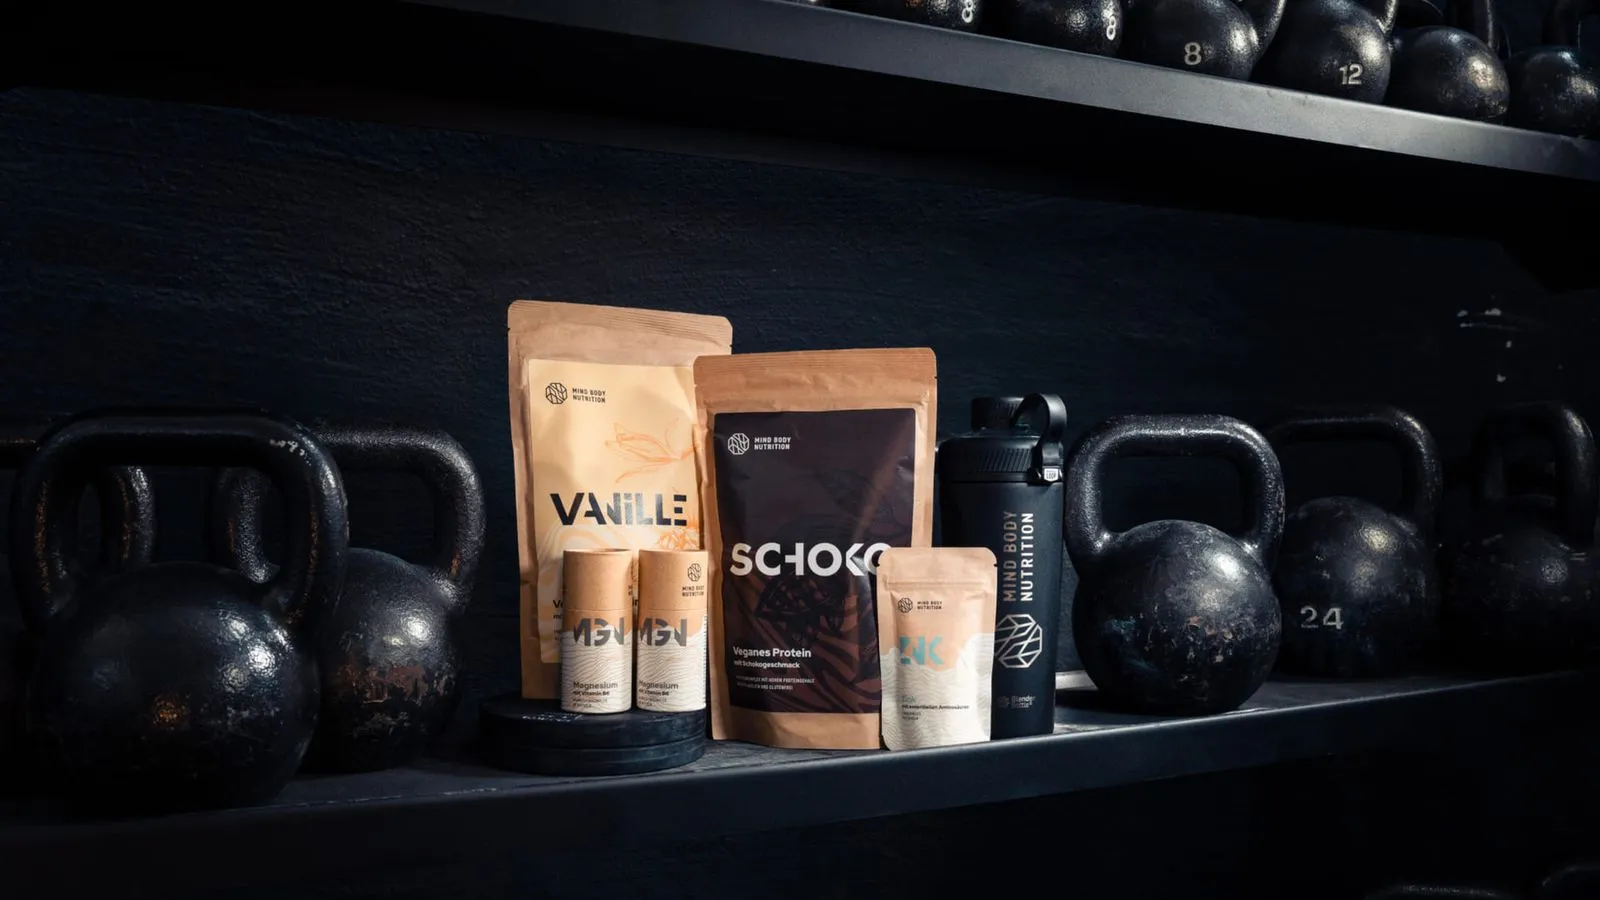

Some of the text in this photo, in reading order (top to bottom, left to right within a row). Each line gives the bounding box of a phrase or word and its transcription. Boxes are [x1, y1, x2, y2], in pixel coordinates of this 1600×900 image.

[1106, 16, 1116, 40] 8
[1184, 42, 1201, 65] 8
[1339, 63, 1363, 85] 12
[572, 387, 606, 397] MIND BODY
[572, 395, 606, 403] NUTRITION
[1003, 511, 1017, 602] MIND BODY
[1020, 512, 1034, 602] NUTRITION
[1300, 606, 1343, 630] 24
[733, 646, 812, 658] Veganes Protein
[743, 661, 801, 669] Schokogeschmack
[573, 681, 618, 690] Magnesium
[639, 680, 678, 690] Magnesium
